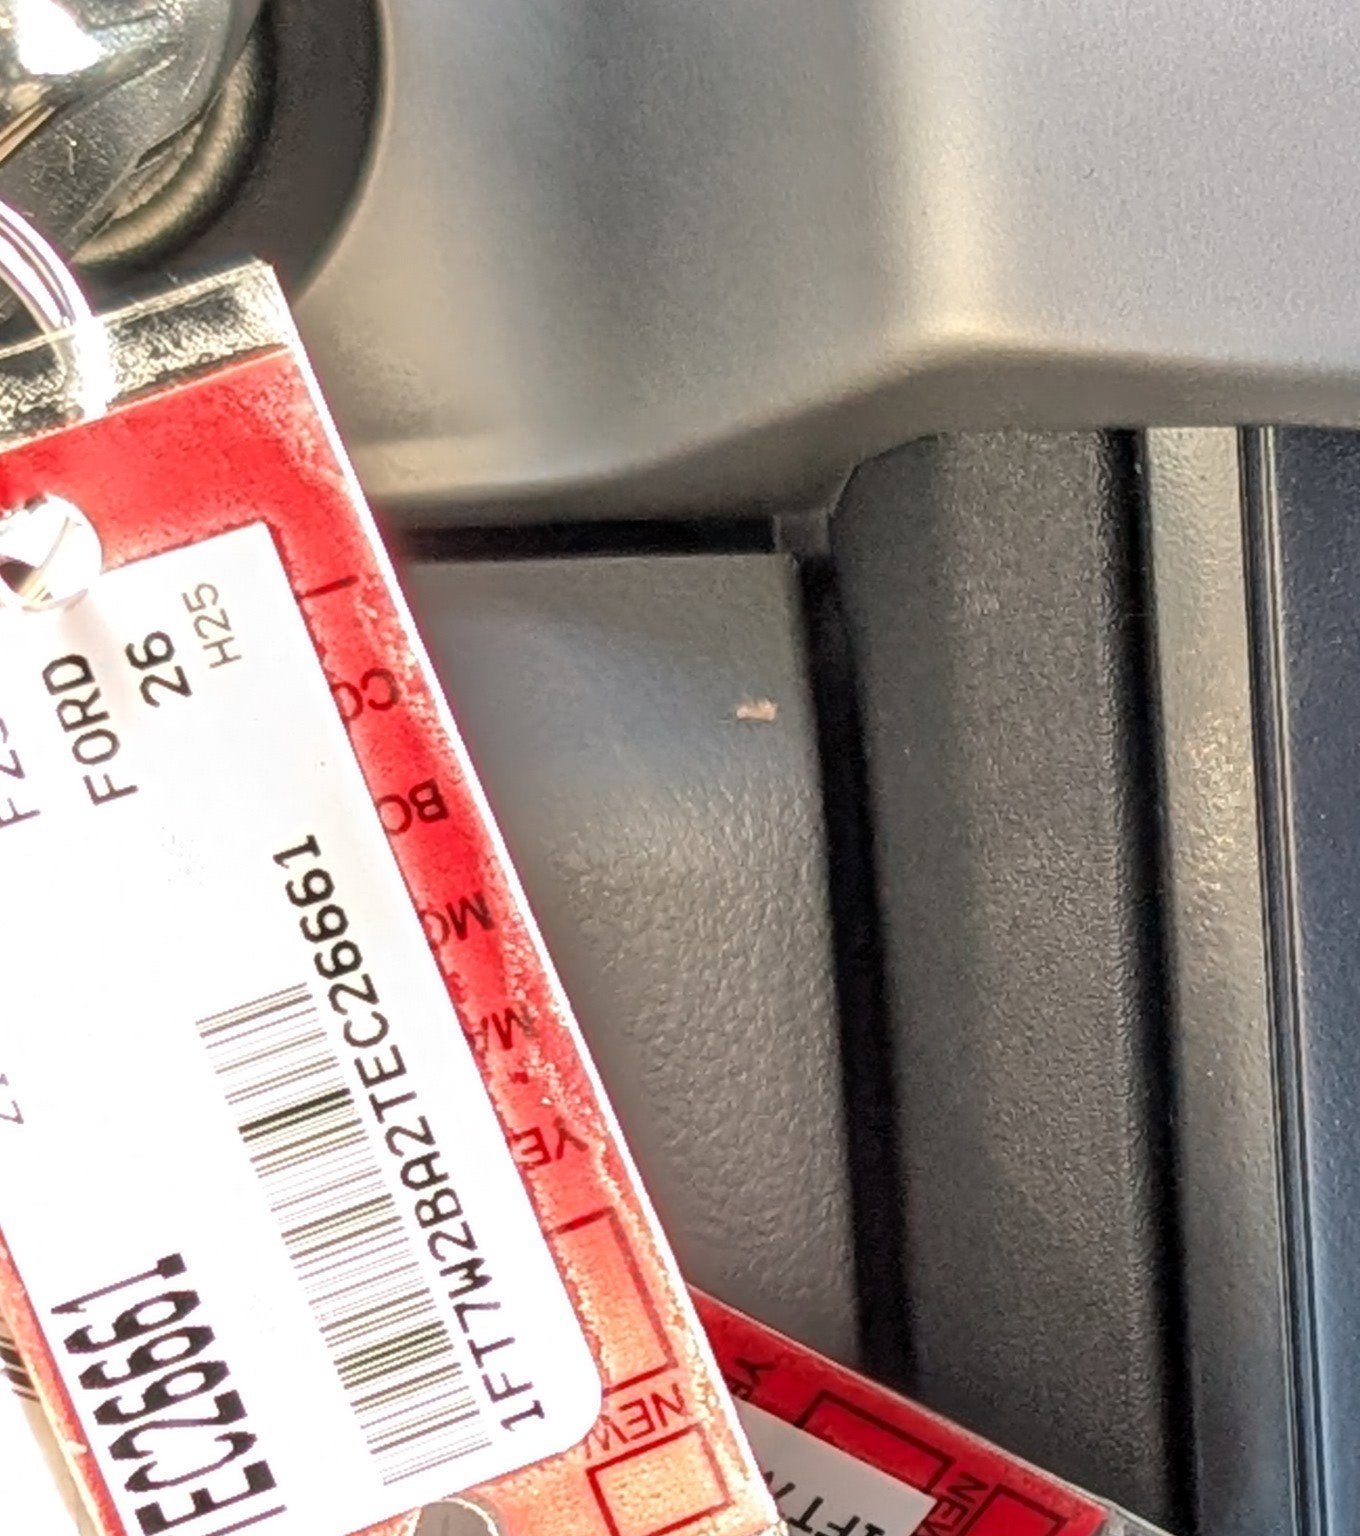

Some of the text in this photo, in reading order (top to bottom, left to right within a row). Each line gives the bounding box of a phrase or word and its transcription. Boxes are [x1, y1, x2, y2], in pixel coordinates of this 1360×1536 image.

[125, 631, 192, 707] 26
[180, 583, 242, 669] H25
[42, 654, 138, 806] FORD
[273, 834, 545, 1431] 1FT7W2BA2TEC26661
